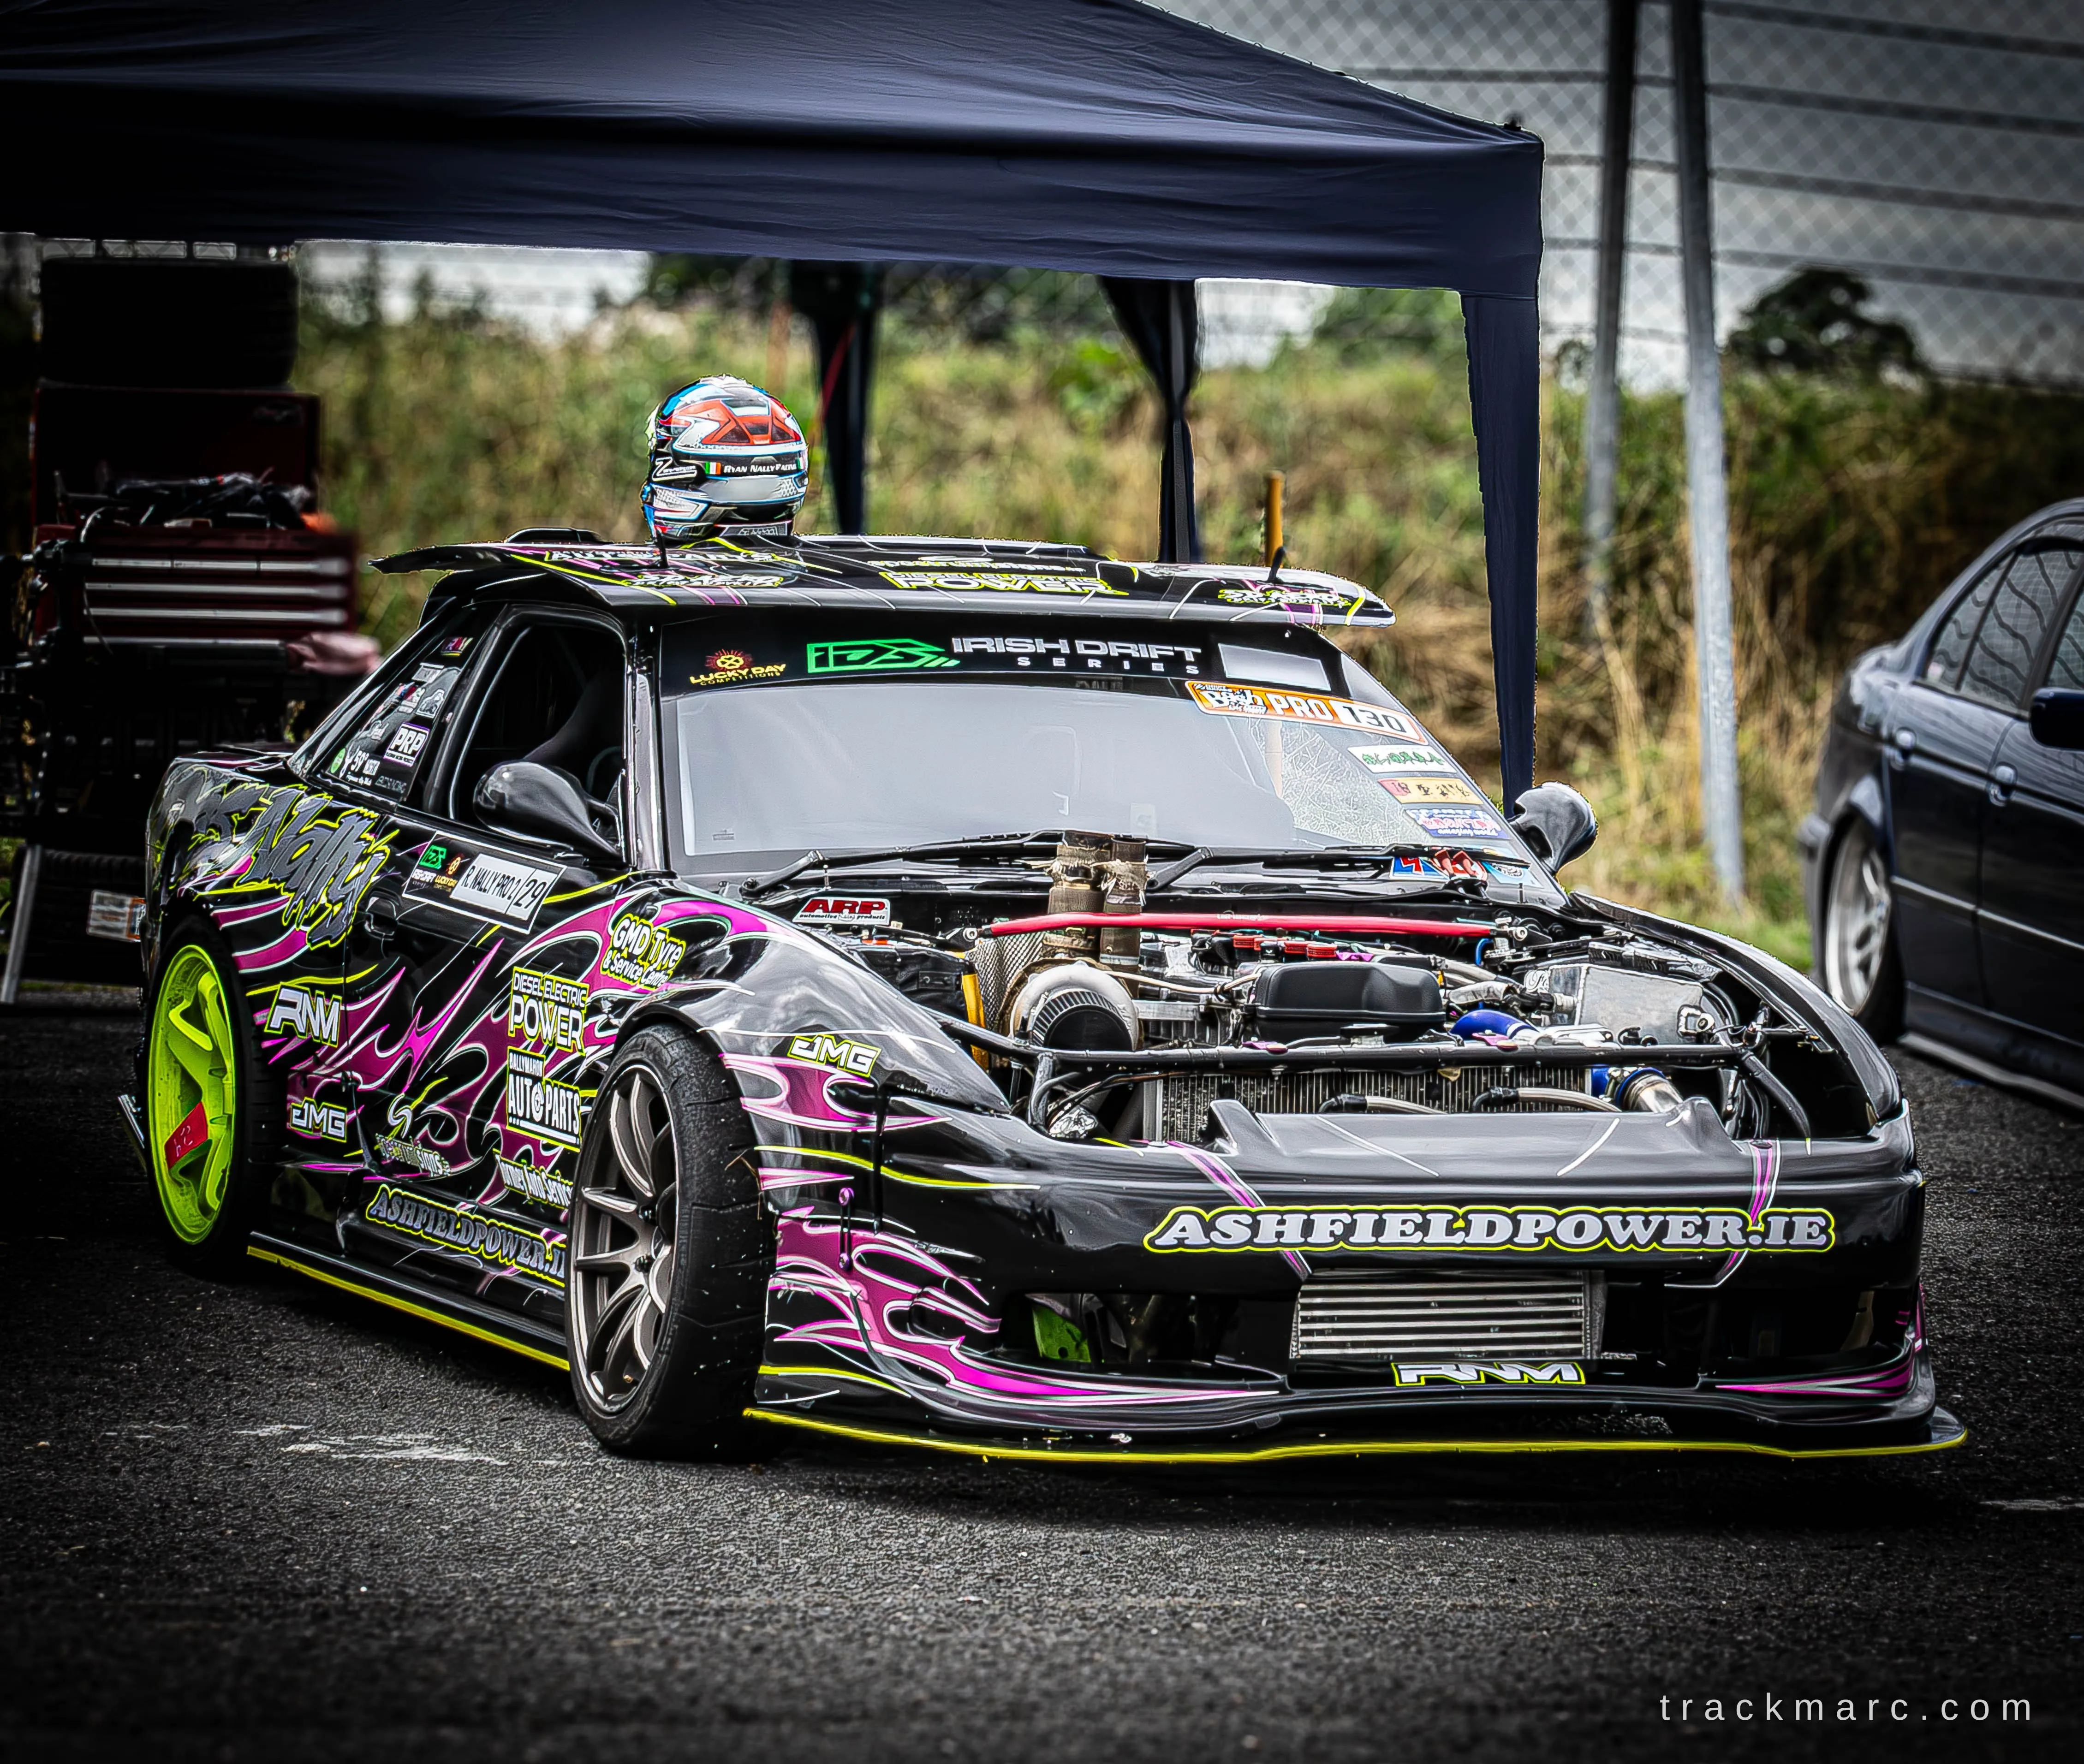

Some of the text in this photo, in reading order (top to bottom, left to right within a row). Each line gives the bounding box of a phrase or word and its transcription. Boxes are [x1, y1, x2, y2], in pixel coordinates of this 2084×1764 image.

[723, 465, 747, 473] RYAN
[750, 464, 775, 473] NALLY
[896, 577, 1111, 593] POWER
[952, 637, 1202, 662] IRISH DRIFT
[690, 664, 786, 684] LUCKY DAY
[1017, 657, 1200, 675] SERIES
[1265, 693, 1336, 723] PRO
[390, 728, 426, 755] PRP
[469, 867, 501, 895] NALLY
[496, 874, 516, 899] PRO
[513, 879, 547, 909] 29
[801, 899, 886, 915] ARP
[613, 919, 683, 969] GMD Tyre
[602, 950, 669, 987] & Service Centre
[513, 973, 586, 1008] DIESEL ELECTRIC
[510, 994, 583, 1050] POWER
[1161, 1213, 1828, 1247] ASHFIELDPOWER.IE
